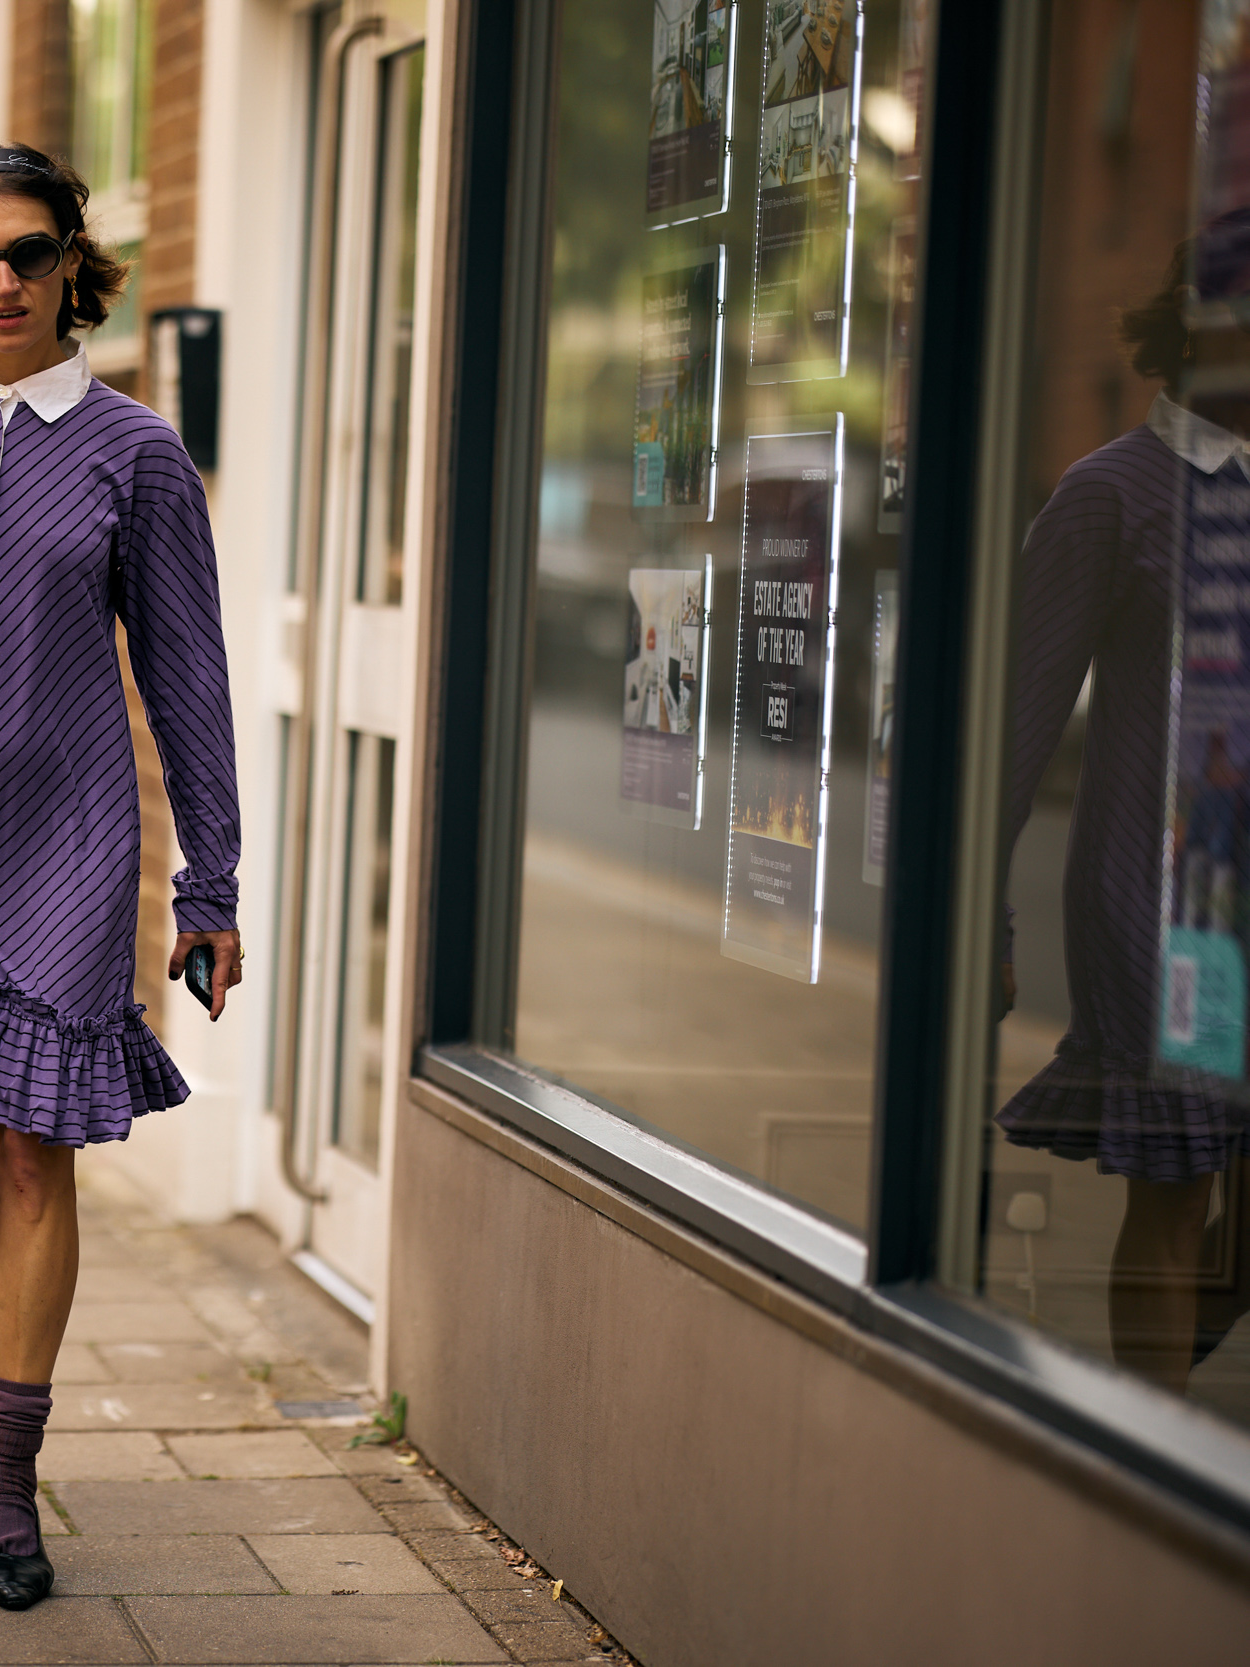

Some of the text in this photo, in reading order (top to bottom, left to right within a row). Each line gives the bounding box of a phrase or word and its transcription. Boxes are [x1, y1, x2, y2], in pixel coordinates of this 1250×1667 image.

[762, 539, 809, 557] PROUD WINNER OF
[753, 581, 813, 619] ESTATE AGENCY
[757, 627, 804, 666] OF THE YEAR
[768, 696, 788, 729] RESI
